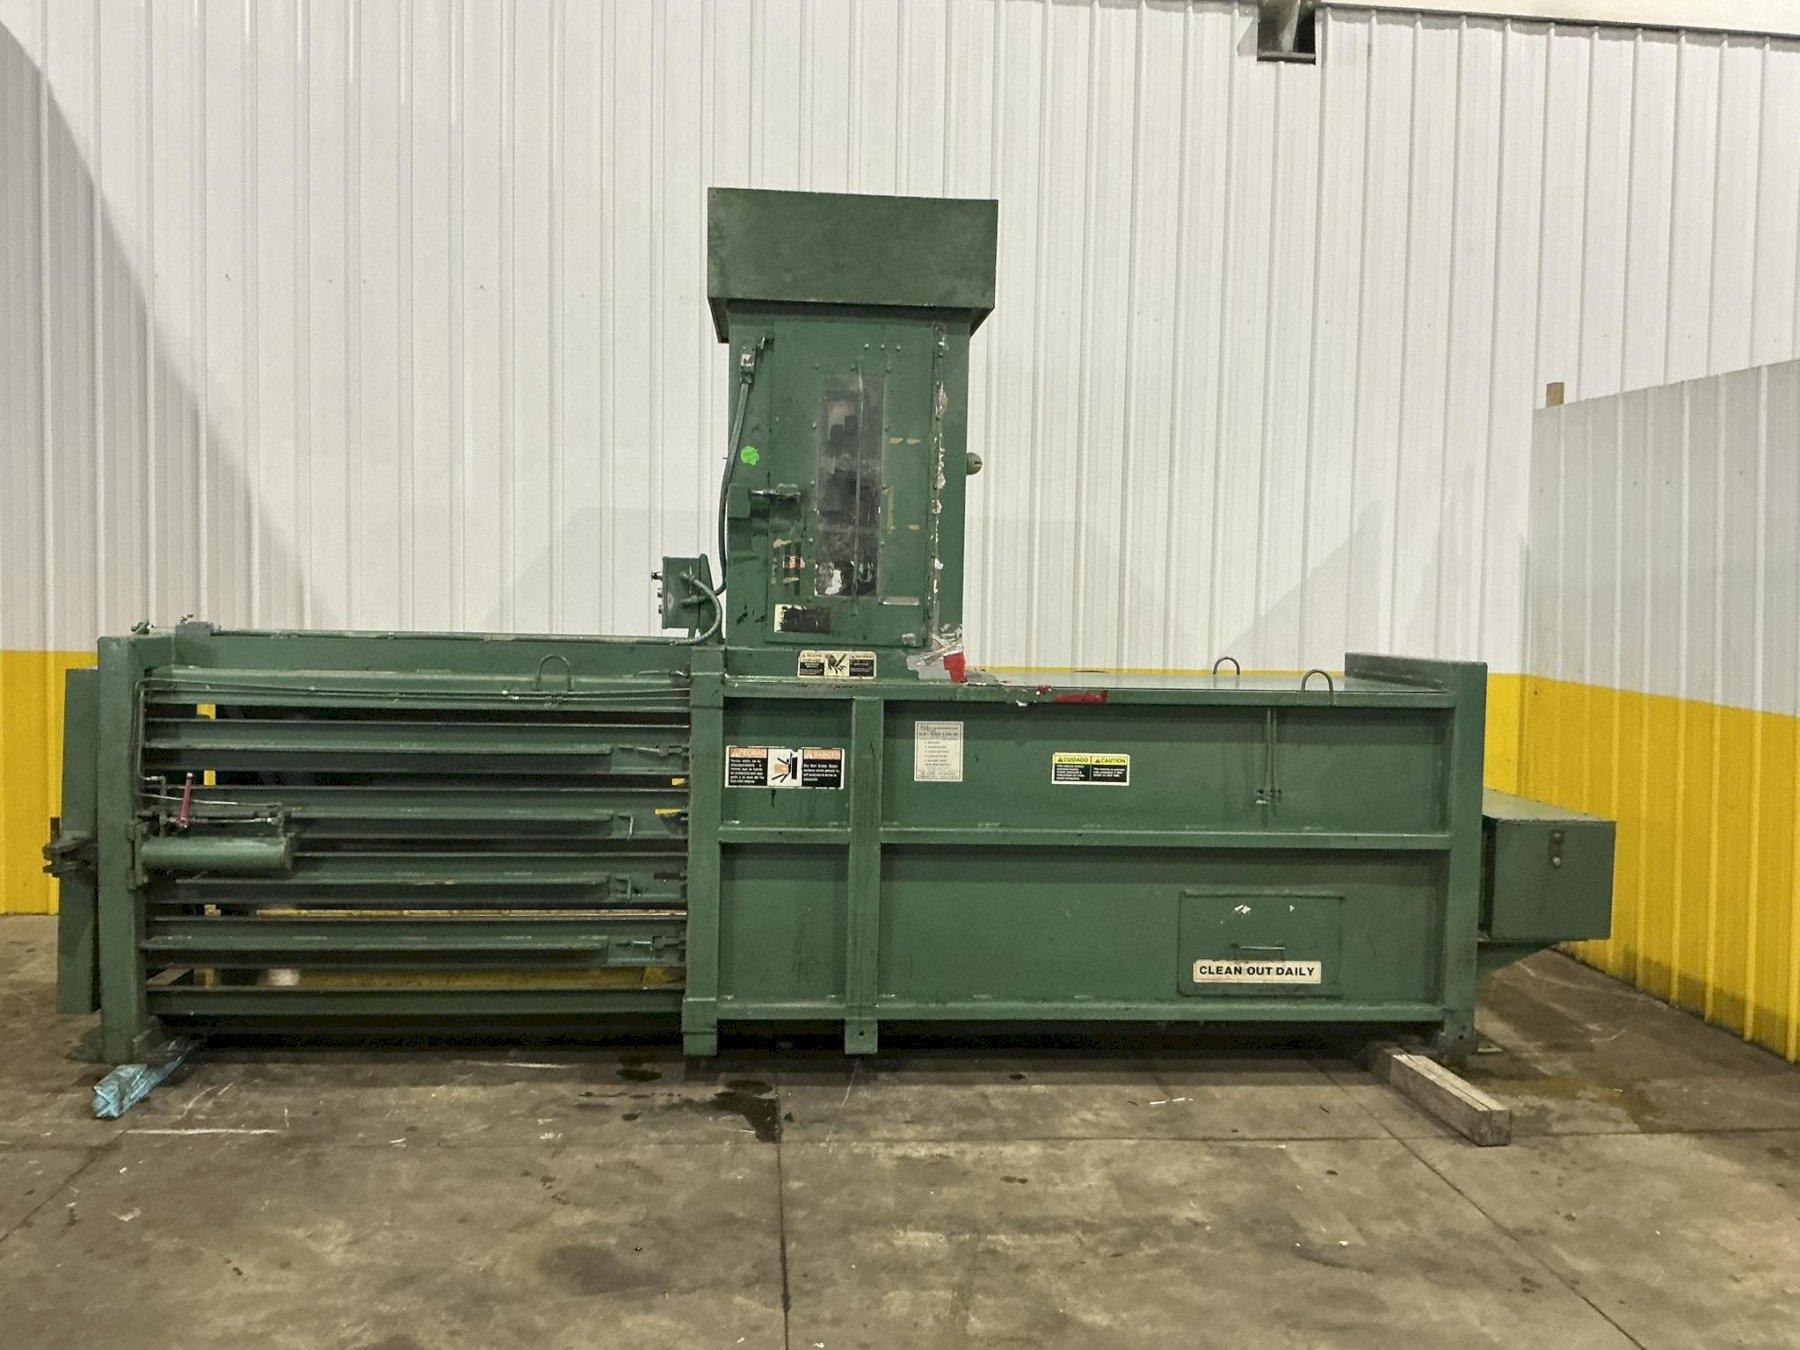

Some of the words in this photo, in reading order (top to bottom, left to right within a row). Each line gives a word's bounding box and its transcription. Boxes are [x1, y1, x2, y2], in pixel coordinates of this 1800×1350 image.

[1199, 965, 1243, 975] CLEAN
[1246, 966, 1273, 976] OUT
[1275, 966, 1315, 976] DAILY
